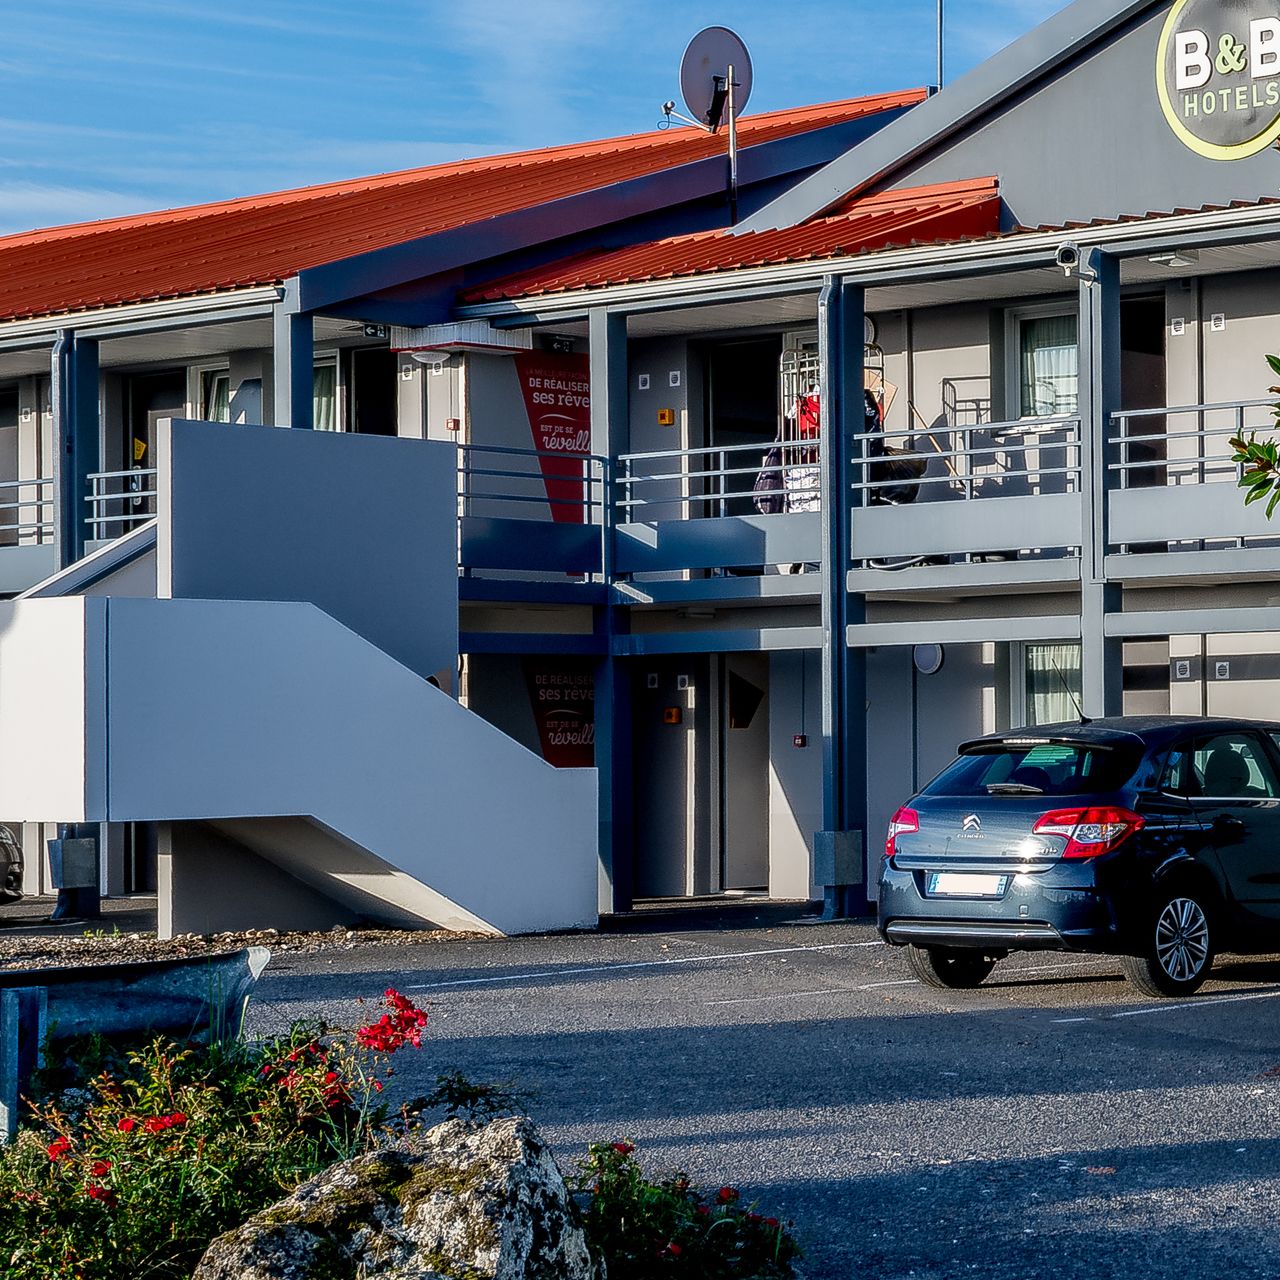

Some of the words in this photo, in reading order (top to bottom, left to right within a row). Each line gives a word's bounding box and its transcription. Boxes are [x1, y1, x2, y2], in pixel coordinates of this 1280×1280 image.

[1183, 81, 1280, 118] HOTELS
[528, 377, 542, 388] DE
[544, 377, 589, 393] RÉALISER
[532, 392, 555, 404] ses
[558, 391, 590, 408] rêve
[540, 424, 553, 432] EST
[554, 425, 564, 433] DE
[564, 426, 574, 434] SE
[542, 430, 592, 452] réveill
[535, 674, 549, 685] DE
[539, 688, 561, 700] ses
[564, 685, 596, 701] rêve
[548, 723, 596, 745] réveill
